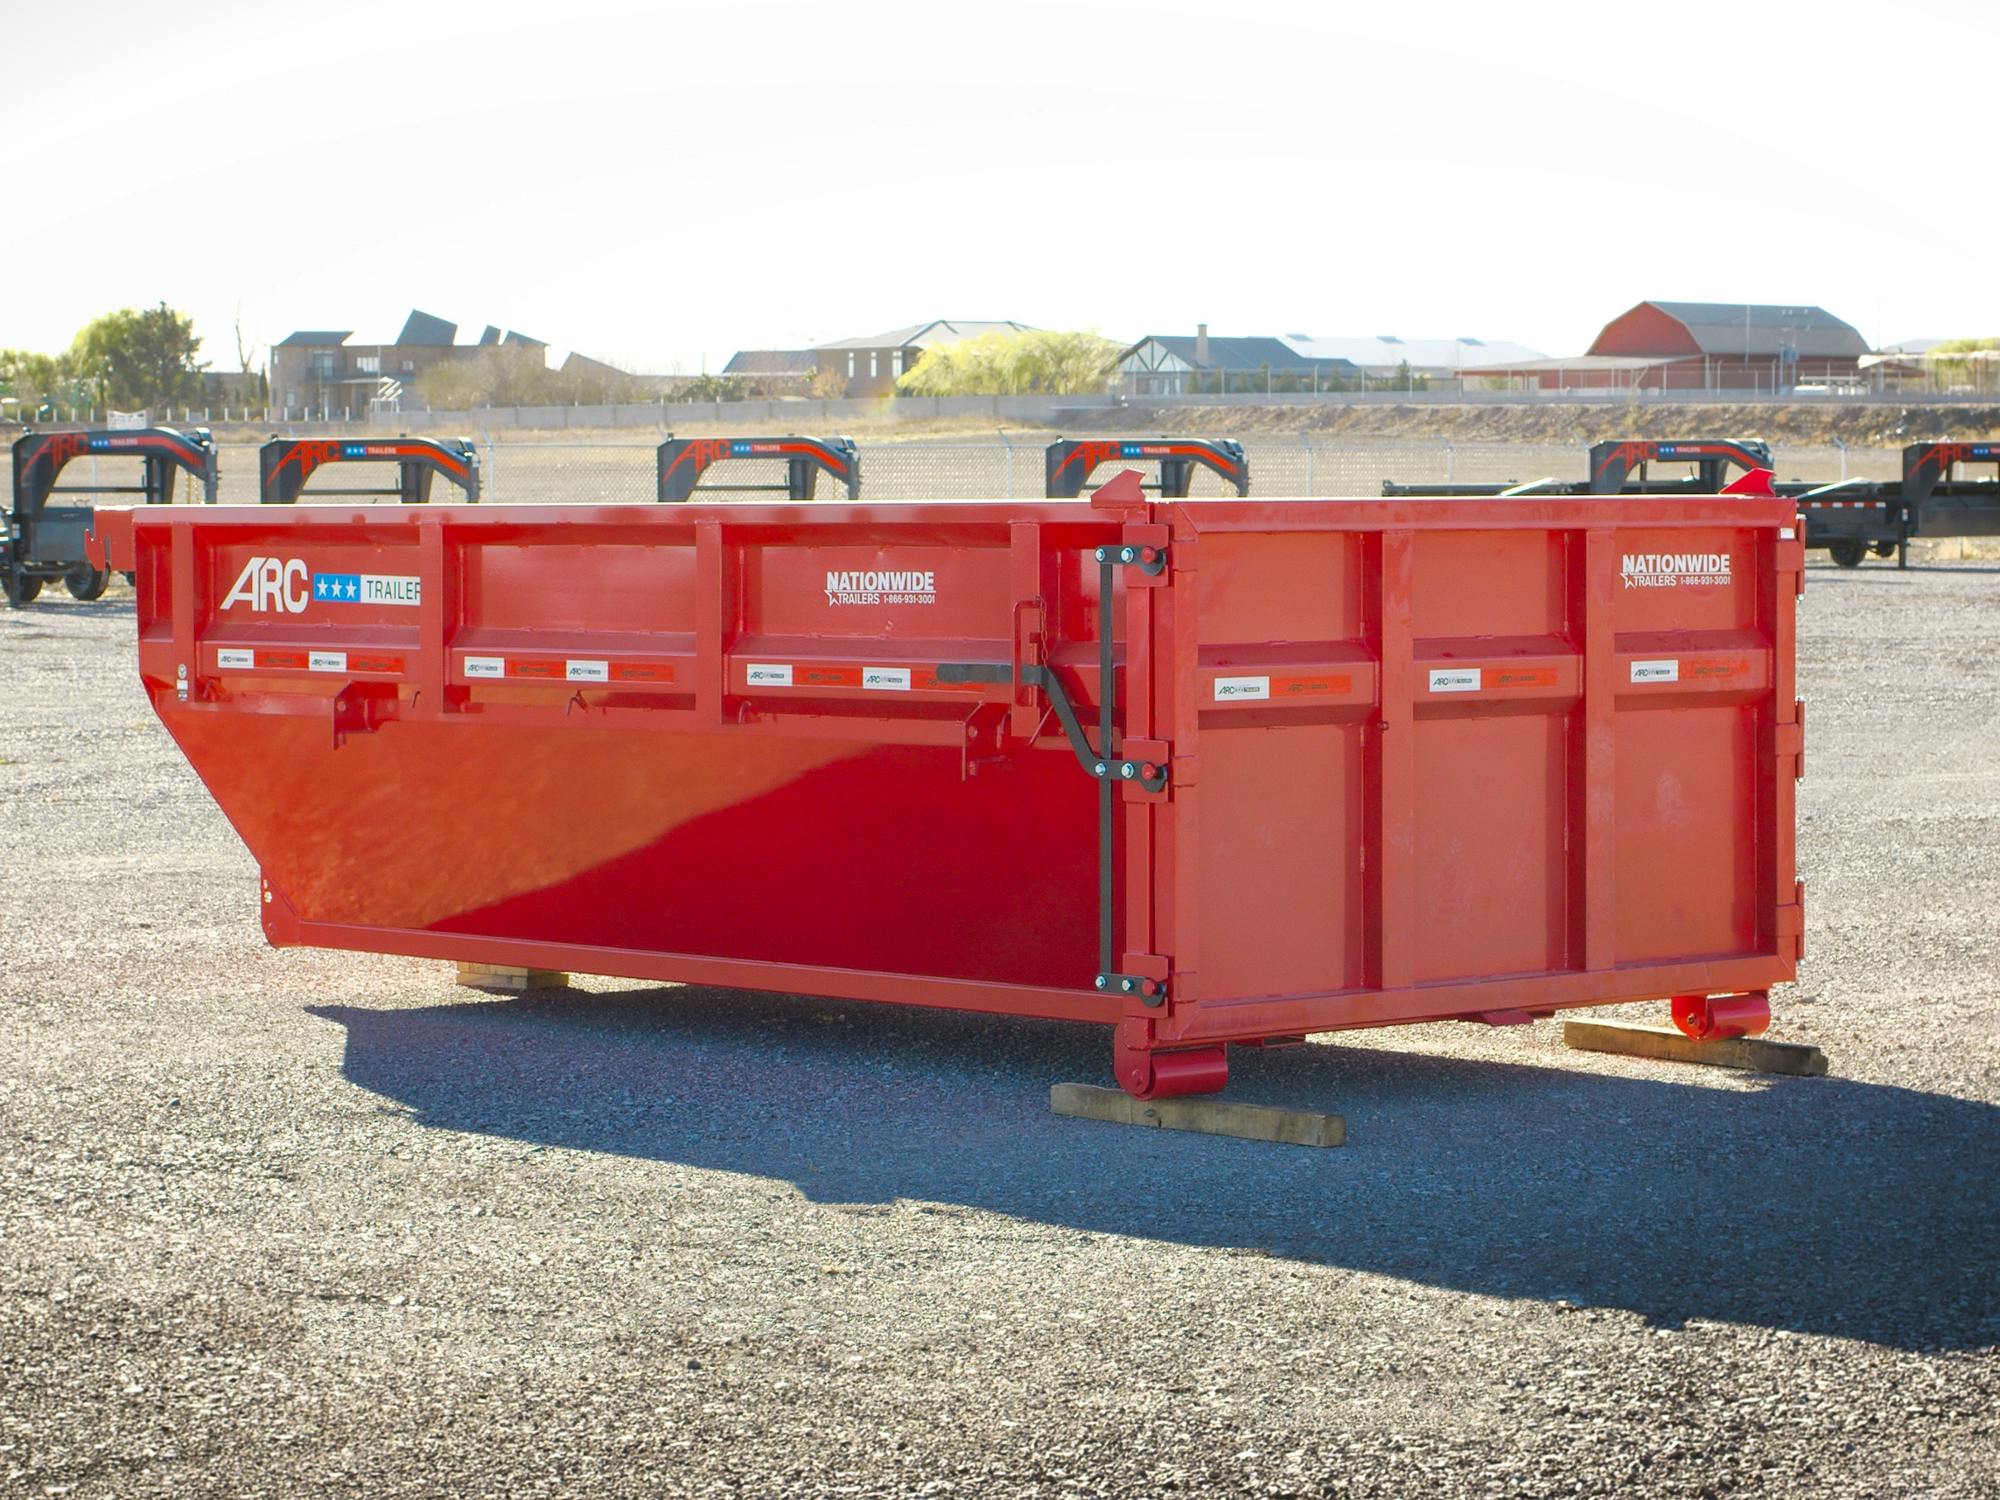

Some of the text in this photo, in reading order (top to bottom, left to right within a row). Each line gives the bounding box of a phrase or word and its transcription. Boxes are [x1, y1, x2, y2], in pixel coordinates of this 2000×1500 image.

[20, 433, 89, 481] ARC
[265, 441, 397, 486] ARC TRAILERS
[662, 439, 731, 484] ARC
[1051, 441, 1121, 484] ARC
[1596, 441, 1659, 479] ARC
[1904, 442, 1973, 478] ARC
[826, 571, 935, 591] NATIONWIDE
[1622, 554, 1730, 573] NATIONWIDE
[1633, 575, 1677, 587] TRAILERS
[219, 556, 309, 614] ARC
[838, 593, 935, 605] TRAILERS 1-866-931-3001
[1218, 685, 1235, 695] ARC
